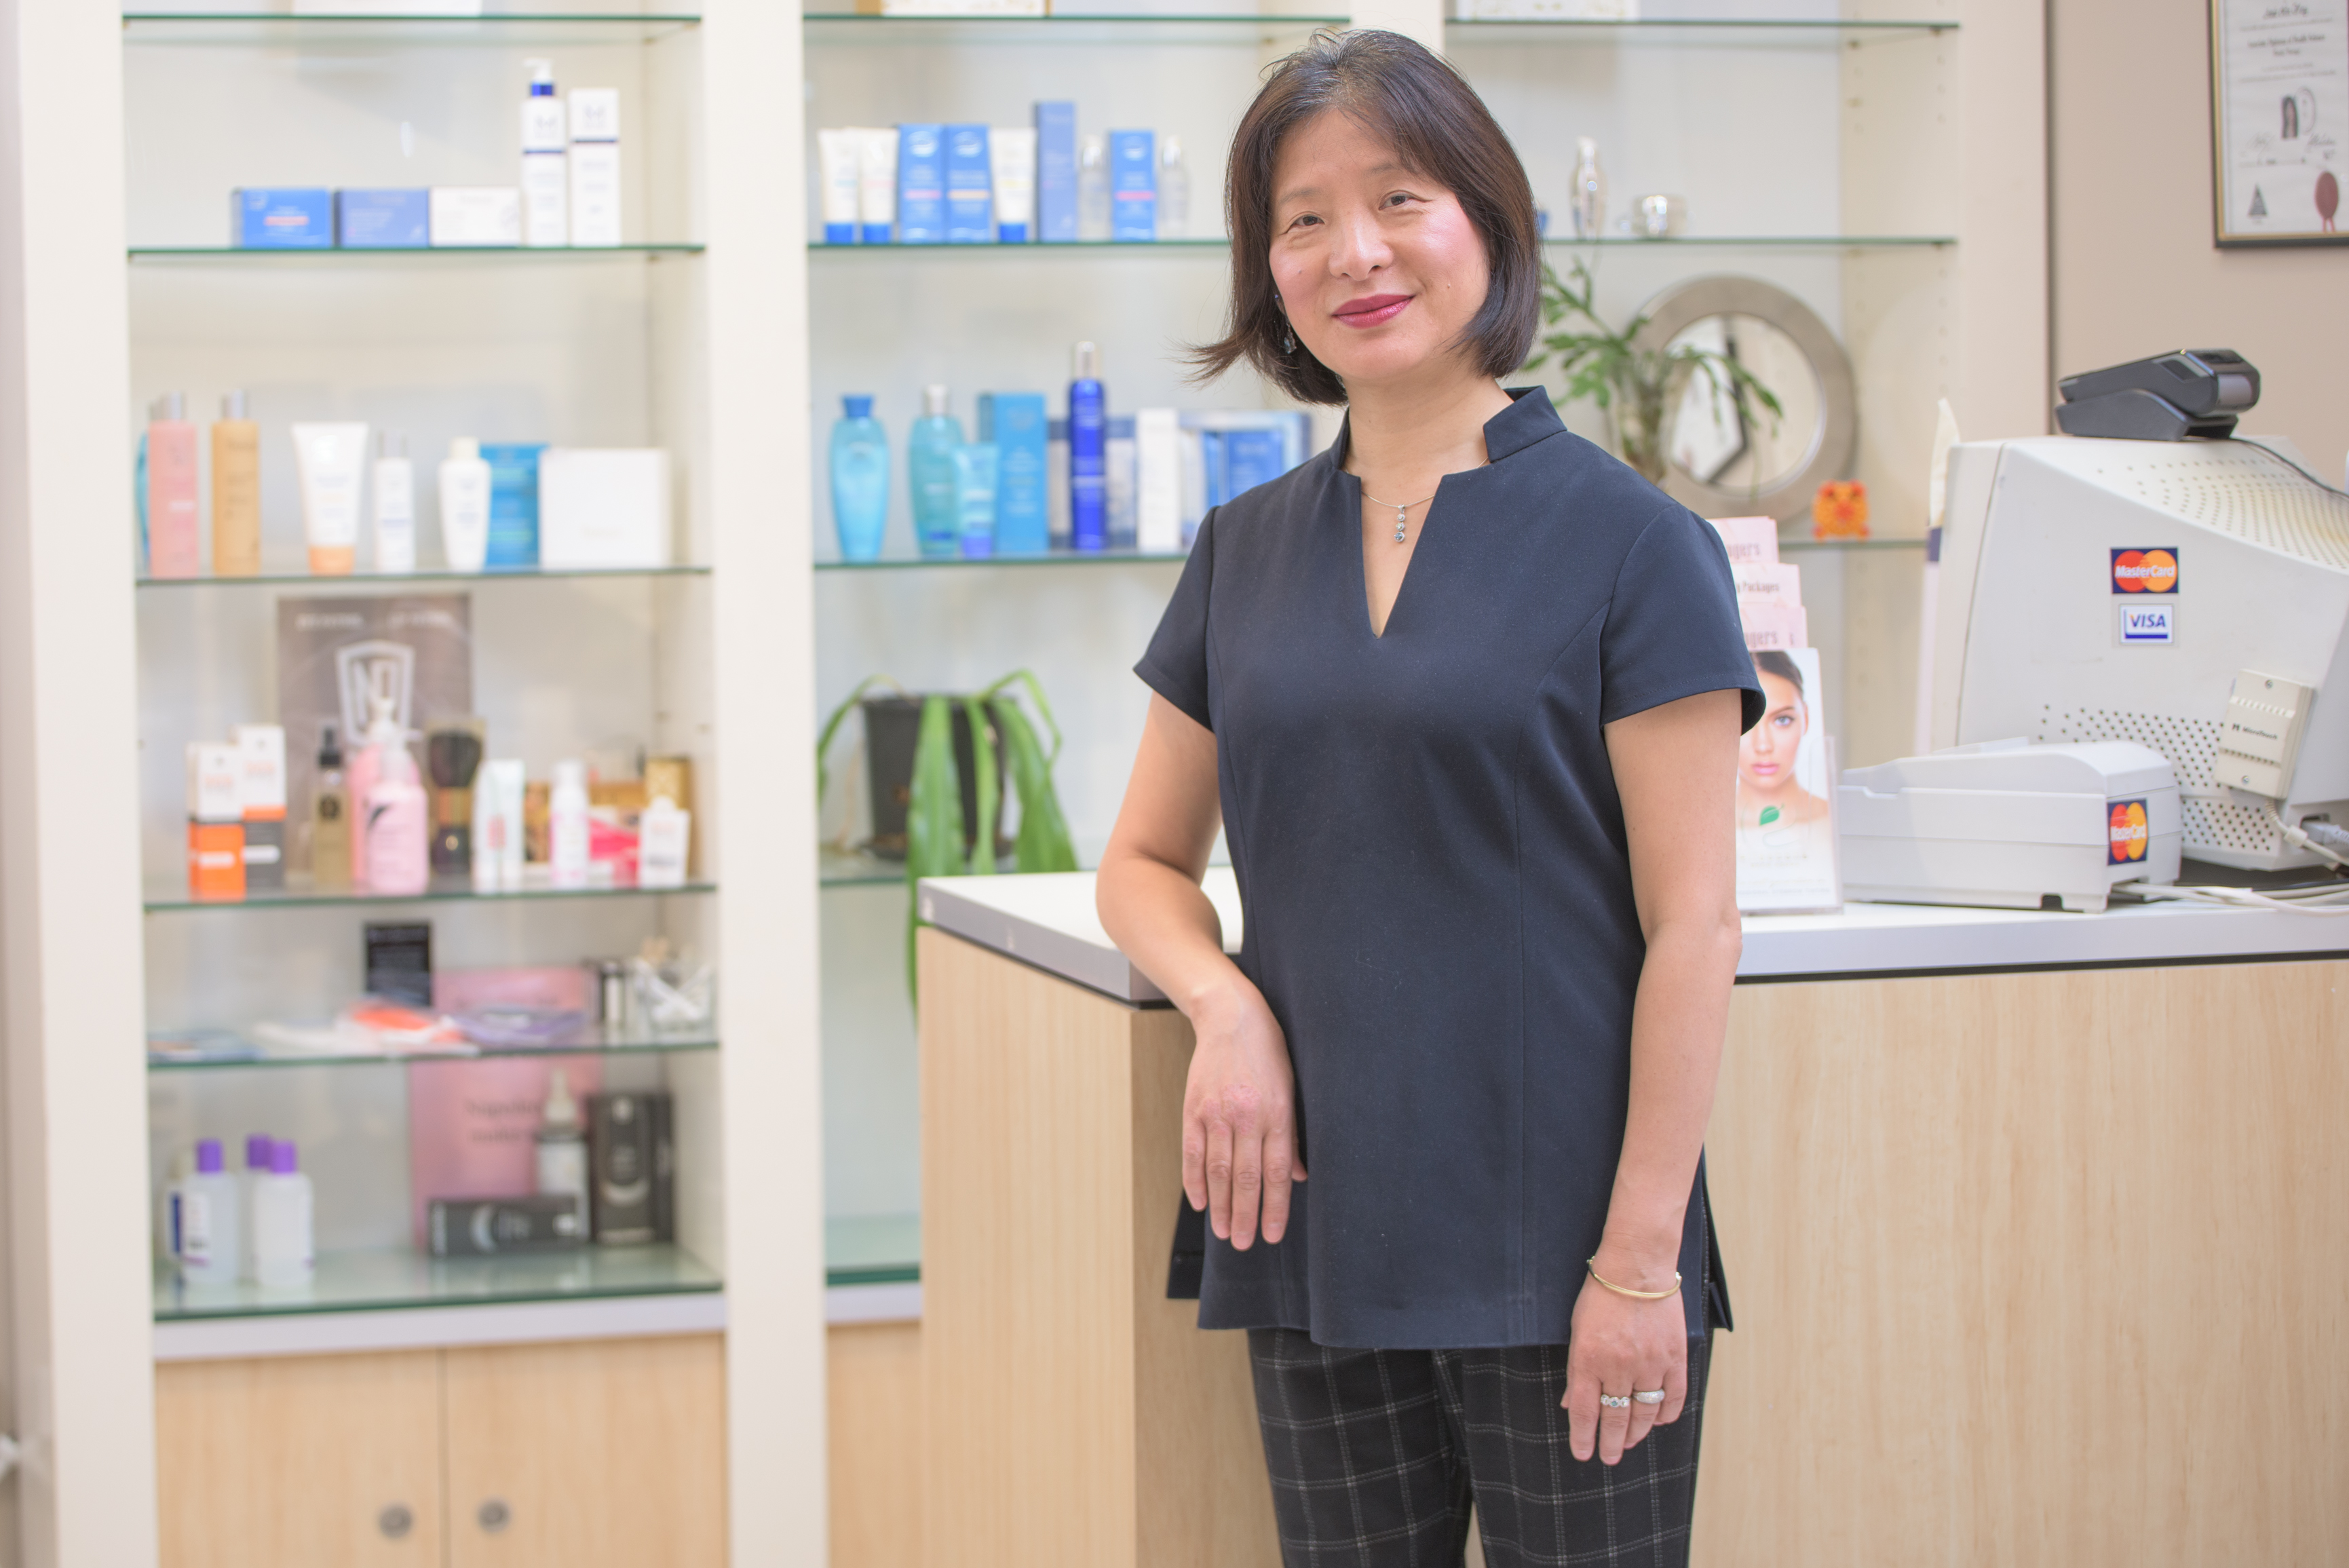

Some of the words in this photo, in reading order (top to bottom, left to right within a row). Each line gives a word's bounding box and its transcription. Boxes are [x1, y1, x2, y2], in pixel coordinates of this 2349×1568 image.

[1727, 542, 1761, 559] ngers
[2115, 565, 2175, 578] MasterCard
[1742, 580, 1780, 594] Packages
[2129, 613, 2166, 628] VISA
[1744, 631, 1778, 647] ngers
[2110, 823, 2147, 841] MasterCard
